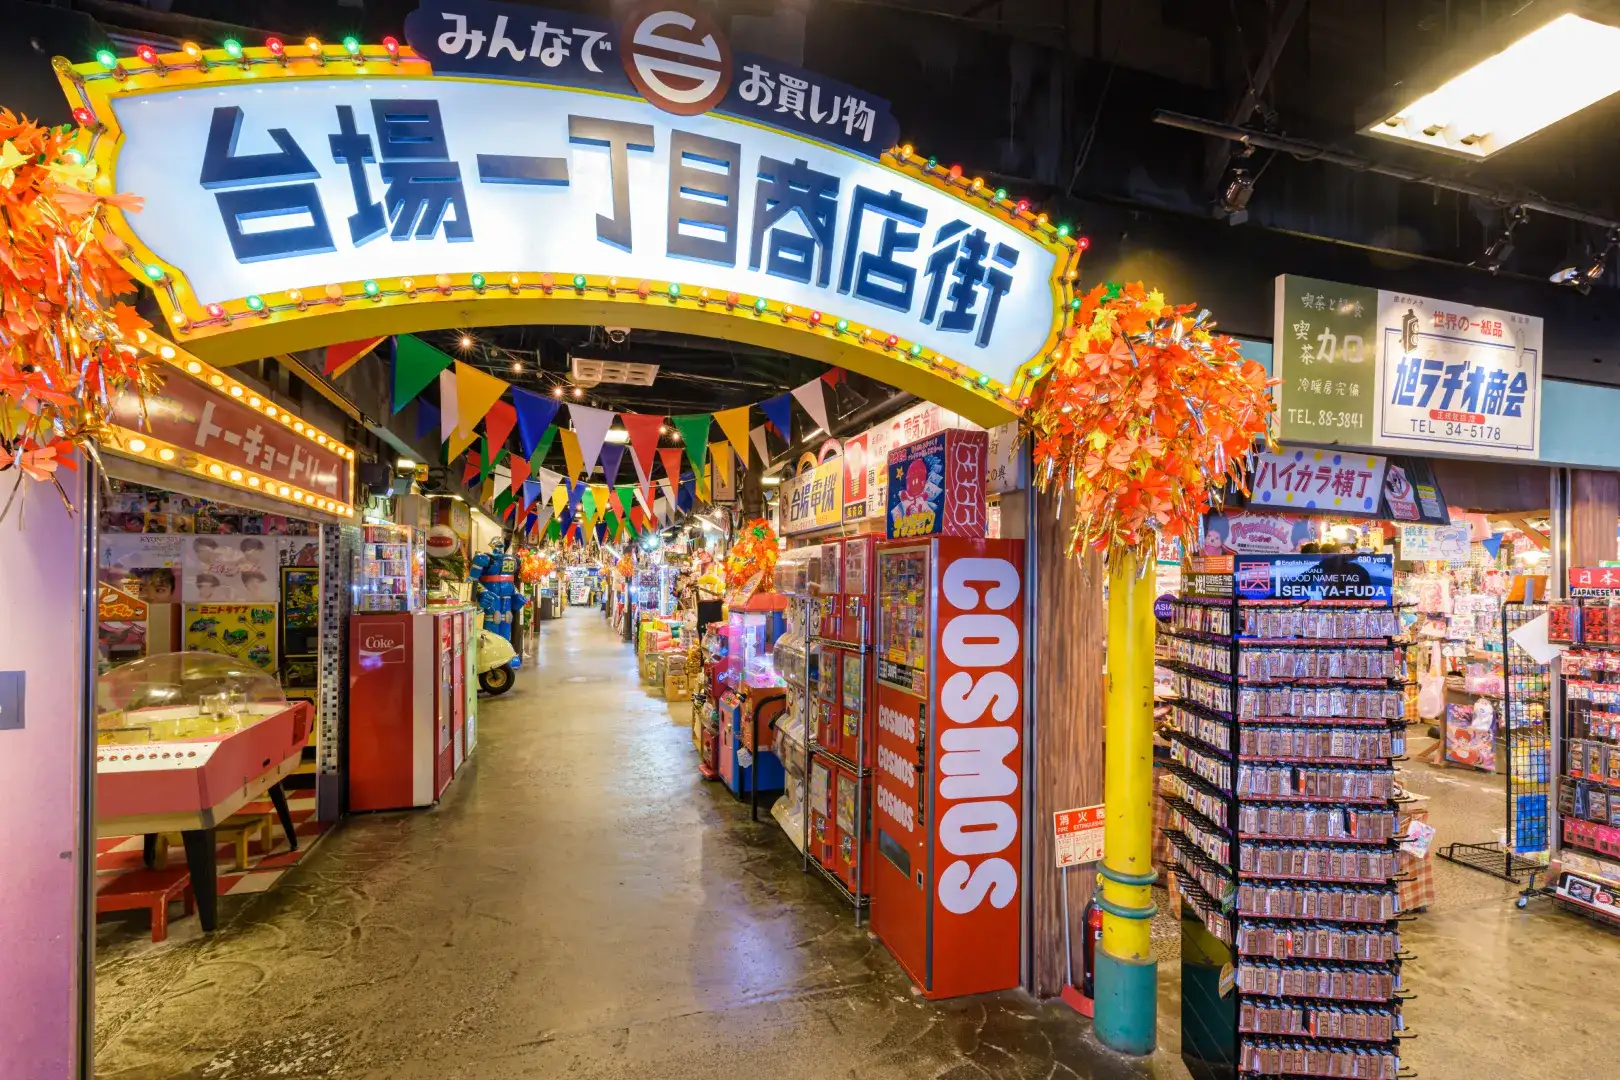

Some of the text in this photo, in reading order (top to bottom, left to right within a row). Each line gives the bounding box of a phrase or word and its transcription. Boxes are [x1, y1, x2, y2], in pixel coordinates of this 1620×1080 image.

[437, 11, 612, 74] みんなで
[738, 63, 876, 142] お買い物
[200, 97, 1020, 349] 台場一丁目商店街
[1292, 320, 1316, 365] 喫茶
[1432, 309, 1503, 338] 世界の一級品
[1297, 377, 1361, 397] 冷暖房完備
[1391, 356, 1528, 418] 旭ラヂオ商会
[1287, 408, 1364, 429] TEL. 88-3841
[1410, 418, 1501, 441] TEL 34-5178
[194, 400, 339, 497] トーキョードリム
[1255, 461, 1373, 499] ハイカラ横丁
[502, 561, 515, 572] 28
[1282, 574, 1360, 583] WOOD NAME TAG
[1373, 556, 1386, 564] yen
[1573, 588, 1610, 598] JAPANESE
[365, 635, 395, 649] Coke
[878, 704, 915, 744] COSMOS
[938, 557, 1021, 915] COSMOS
[877, 744, 915, 789] COSMOS
[876, 784, 914, 833] COSMOS
